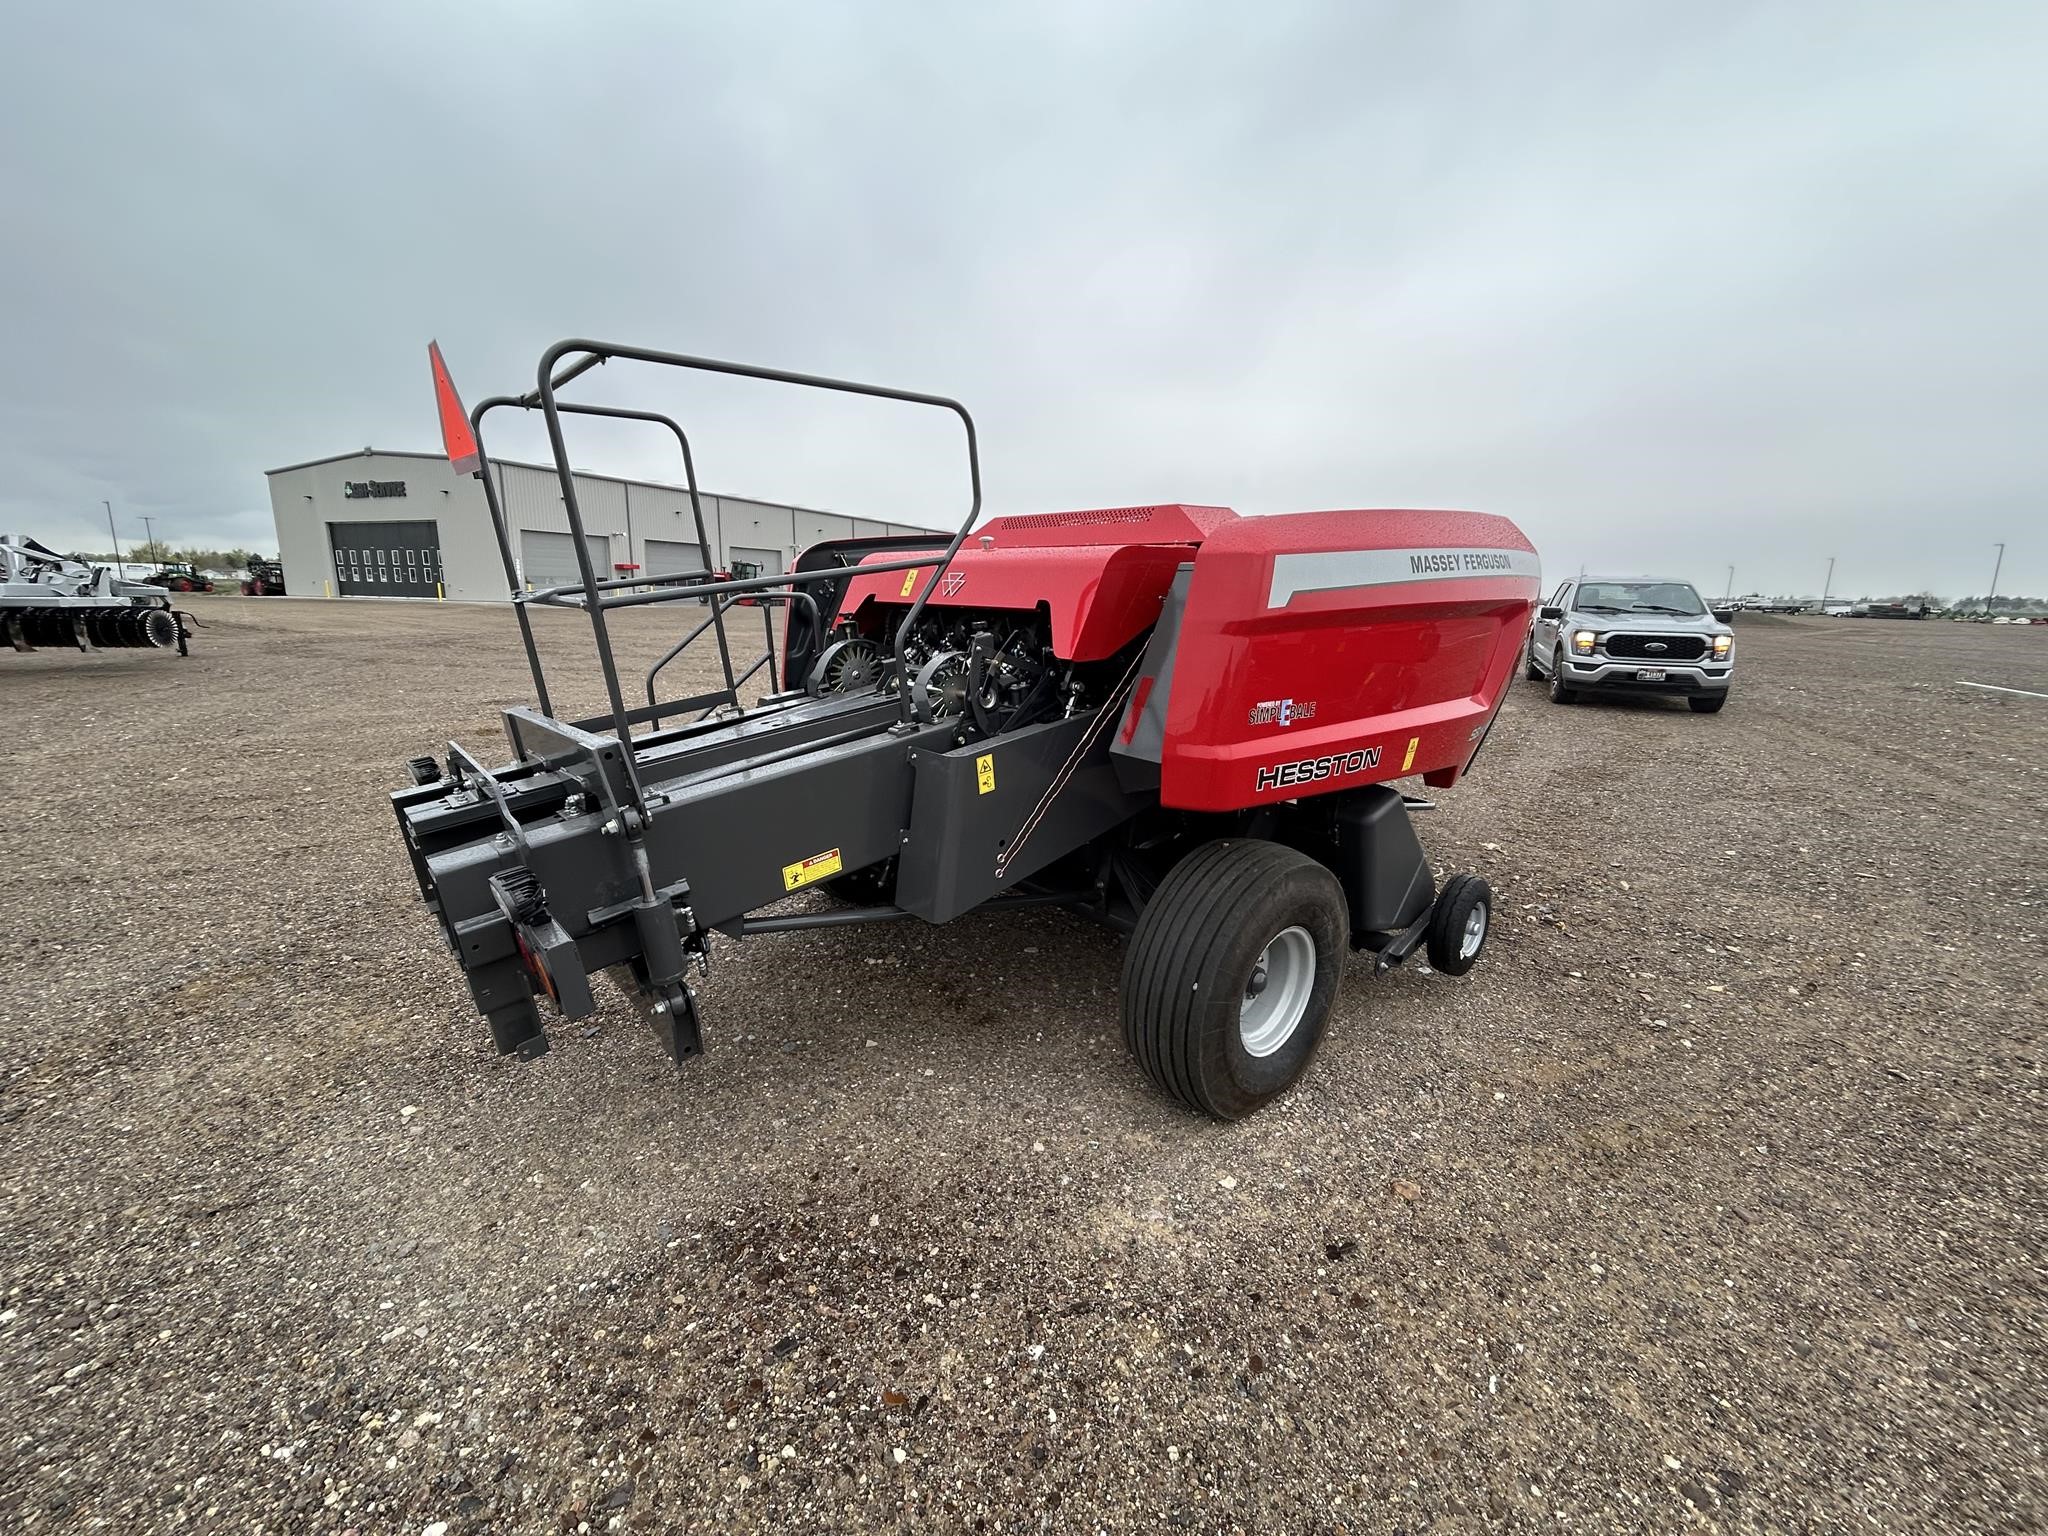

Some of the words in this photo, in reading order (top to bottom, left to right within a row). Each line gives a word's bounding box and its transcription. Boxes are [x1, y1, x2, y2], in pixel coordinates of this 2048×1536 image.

[1410, 554, 1461, 573] MASSEY
[1463, 553, 1512, 570] FERGUSON
[1255, 746, 1383, 792] HESSTON
[813, 853, 833, 864] DANGER
